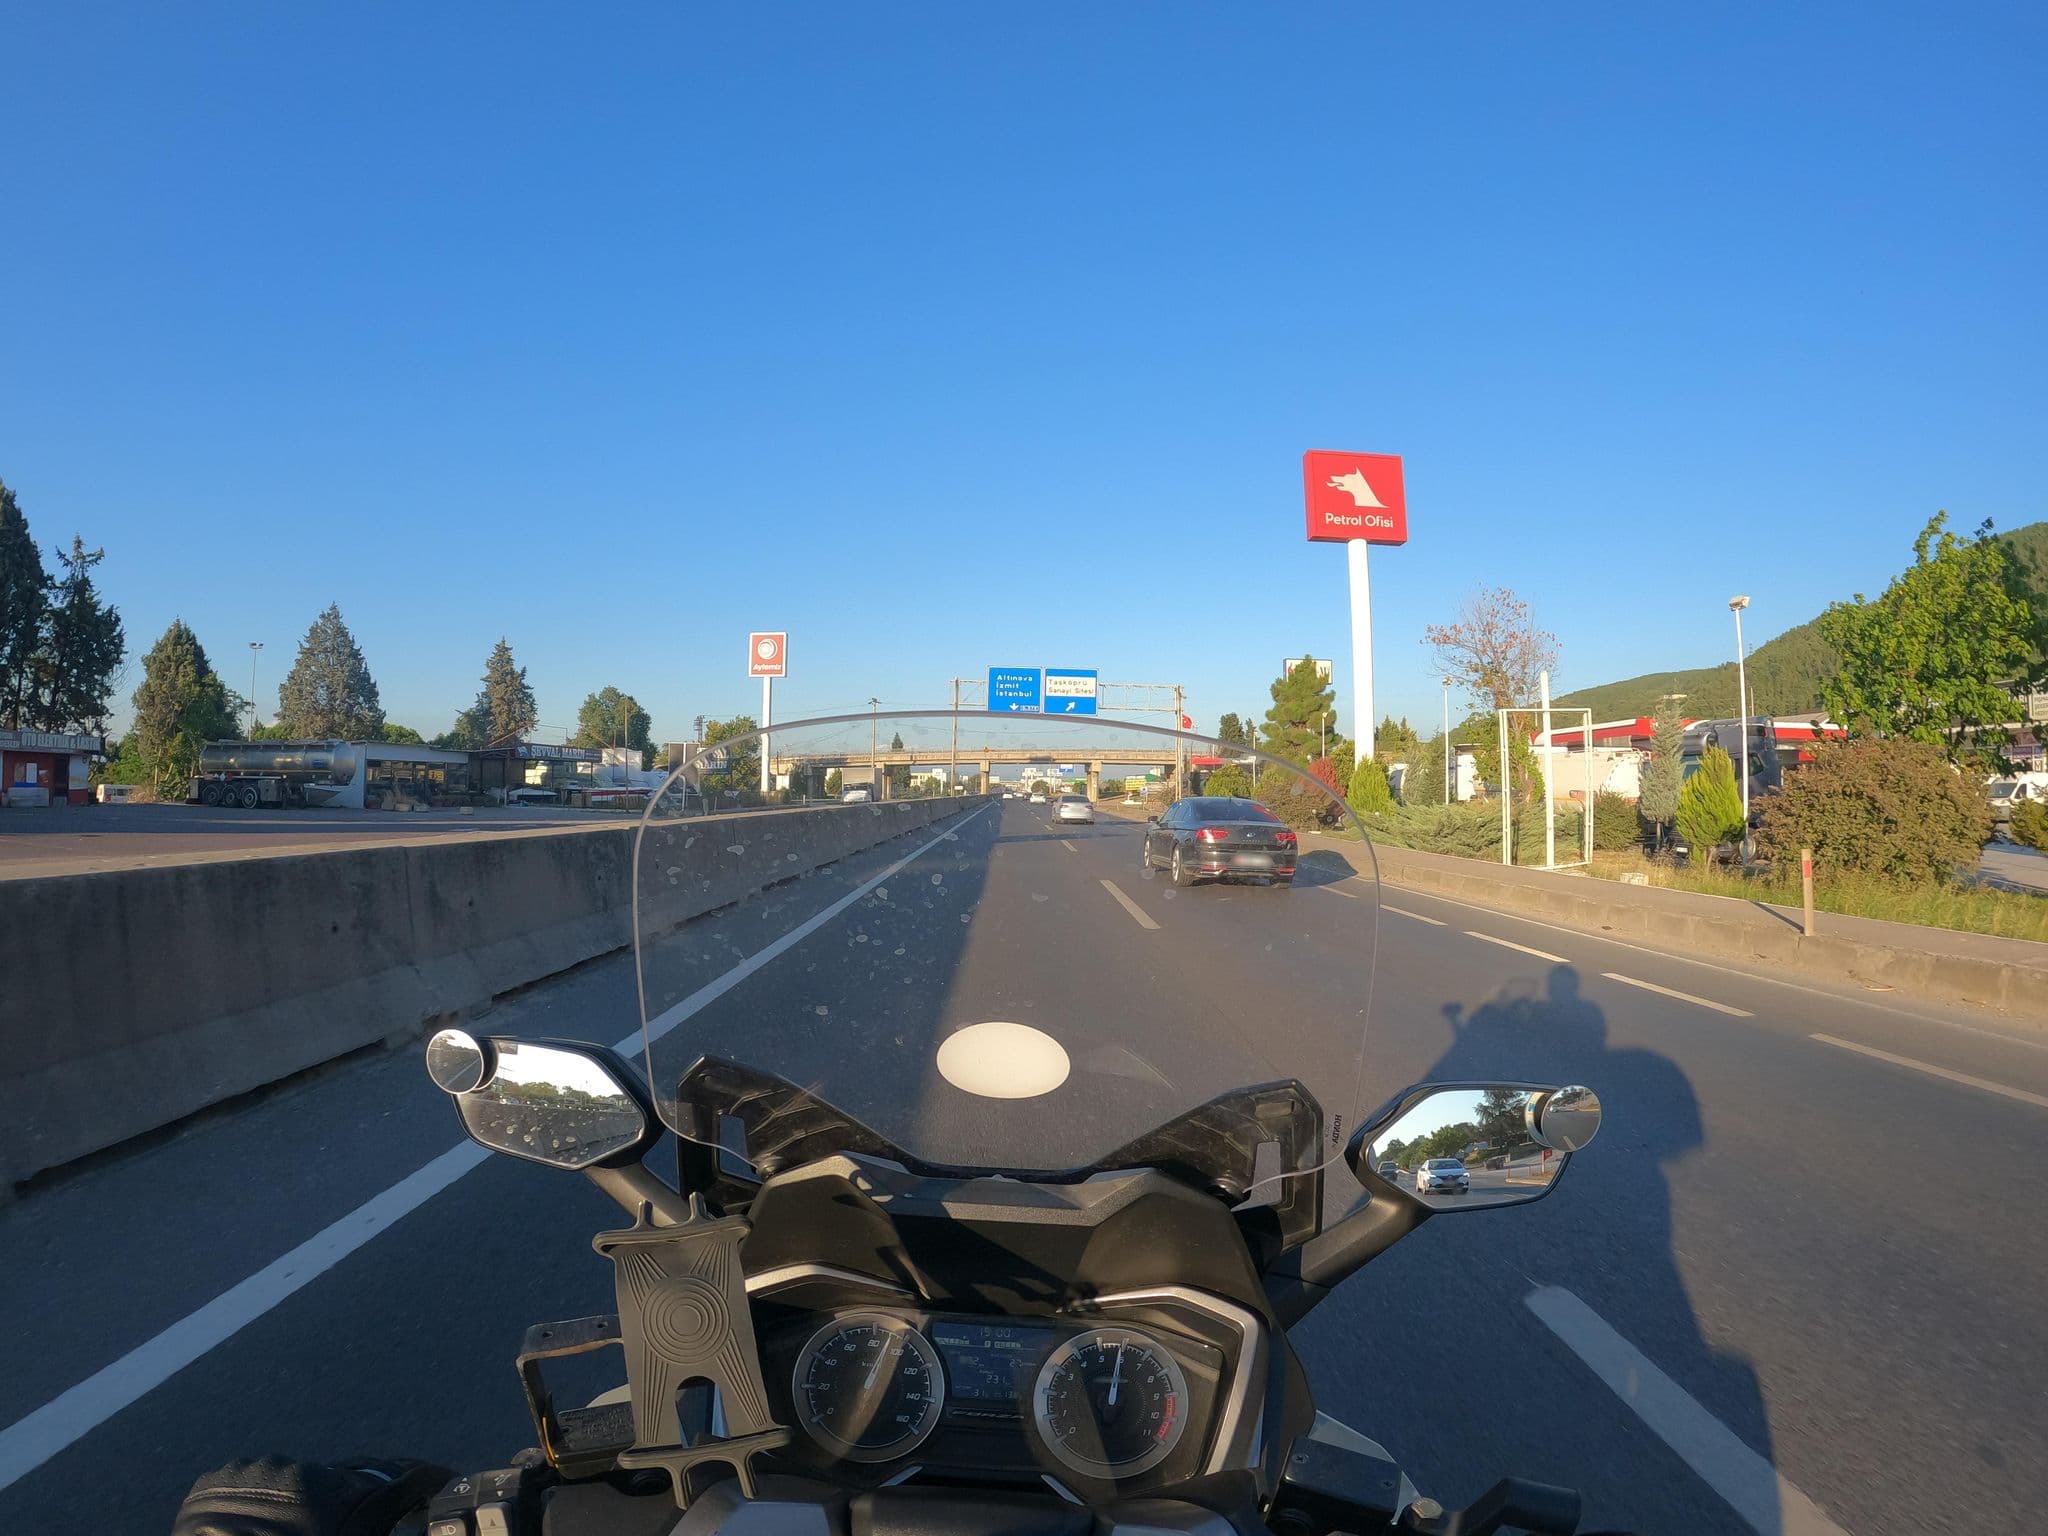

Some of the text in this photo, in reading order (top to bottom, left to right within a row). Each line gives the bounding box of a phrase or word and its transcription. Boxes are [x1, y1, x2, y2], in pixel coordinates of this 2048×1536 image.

[1325, 512, 1394, 528] Petrol Ofisi
[1332, 1114, 1342, 1144] HONDA
[867, 1339, 880, 1347] 80
[843, 1344, 856, 1352] 60
[824, 1358, 837, 1366] 40
[1098, 1355, 1105, 1363] 5
[1081, 1360, 1087, 1368] 4
[903, 1367, 918, 1375] 120
[1067, 1373, 1074, 1381] 3
[1147, 1375, 1155, 1383] 8
[818, 1383, 830, 1391] 20
[905, 1392, 921, 1401] 140
[1060, 1391, 1067, 1399] 2
[1153, 1393, 1160, 1401] 9
[827, 1407, 834, 1415] 0
[1150, 1411, 1160, 1419] 10
[1069, 1426, 1076, 1434] 0
[1142, 1429, 1152, 1437] 11
